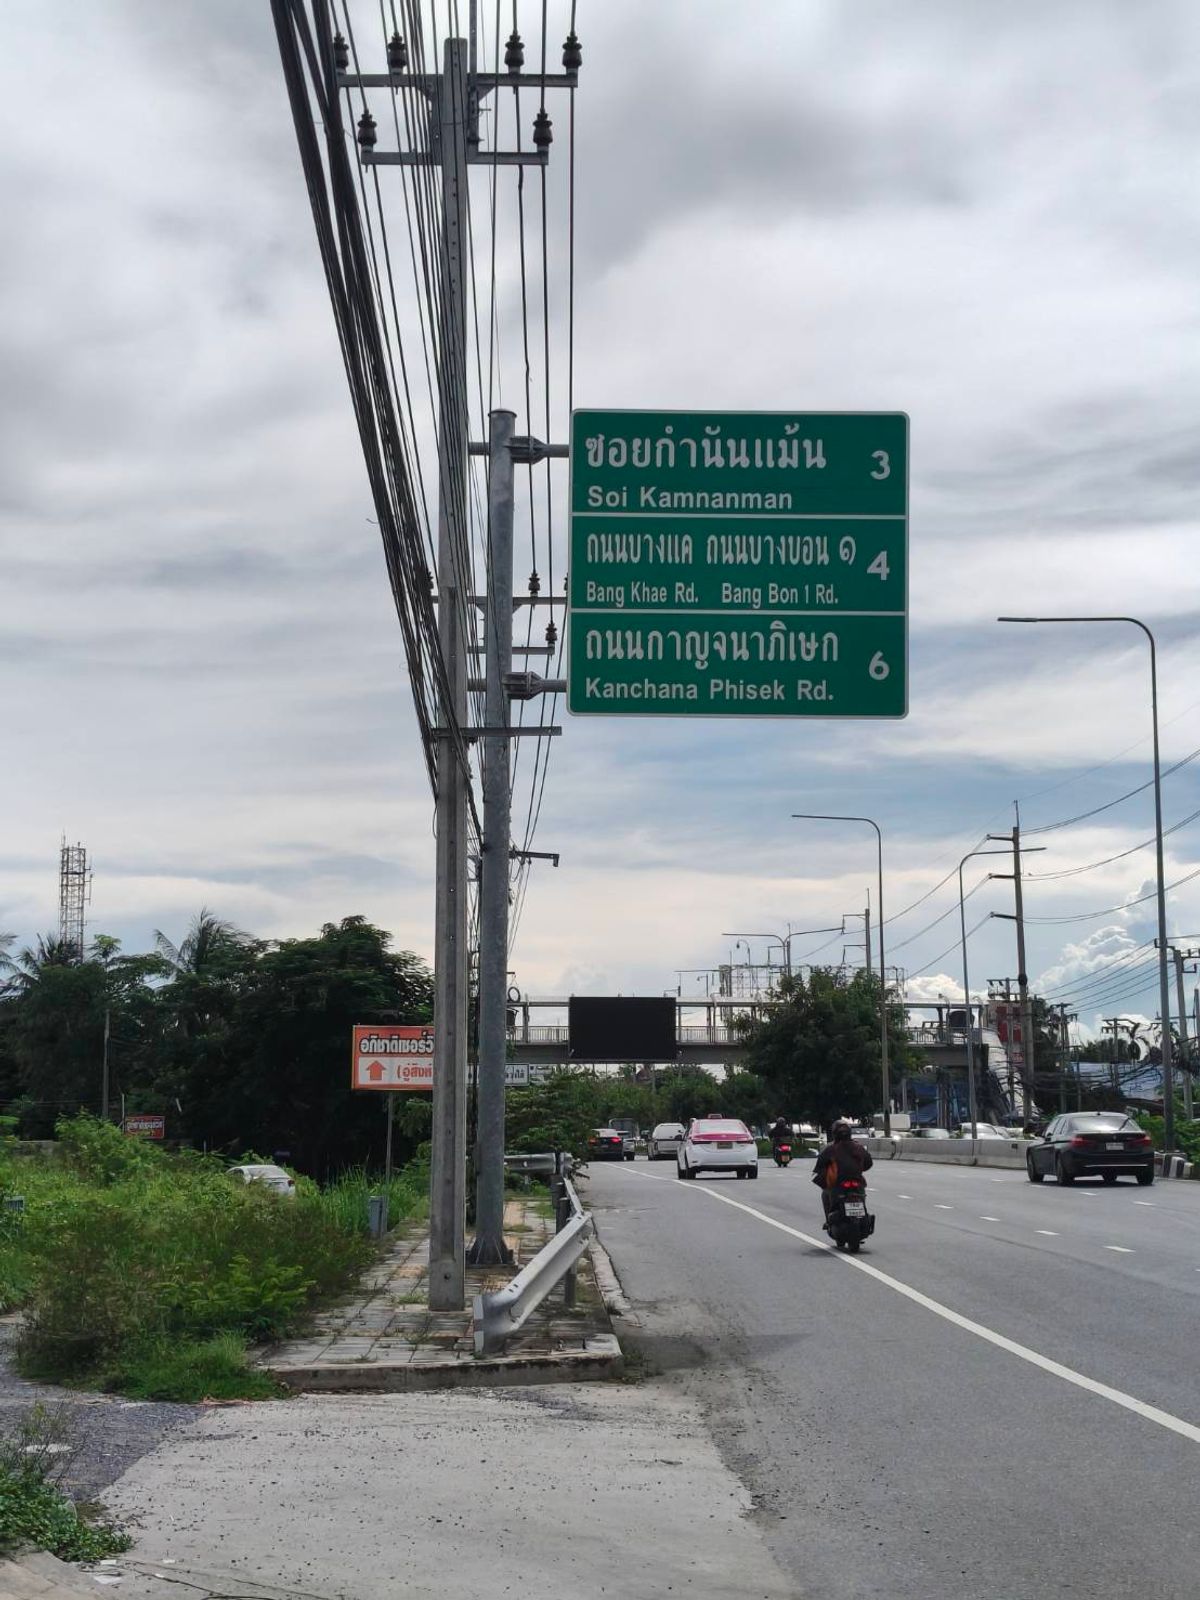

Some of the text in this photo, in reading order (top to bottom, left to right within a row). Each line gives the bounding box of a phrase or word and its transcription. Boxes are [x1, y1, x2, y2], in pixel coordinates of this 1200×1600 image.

[586, 424, 827, 469] ซอยกำนันแม้น
[870, 451, 891, 480] 3
[588, 486, 792, 509] Soi Kamnanman
[587, 533, 856, 565] ถนนบางแค ถนนบางบอน ๑
[867, 551, 890, 580] 4
[587, 582, 838, 609] Bang Khae Rd. Bang Bon 1 Rd.
[586, 621, 838, 670] ถนนกาญจนาภิเษก
[868, 651, 890, 680] 6
[586, 678, 834, 700] Kanchana Phisek Rd.
